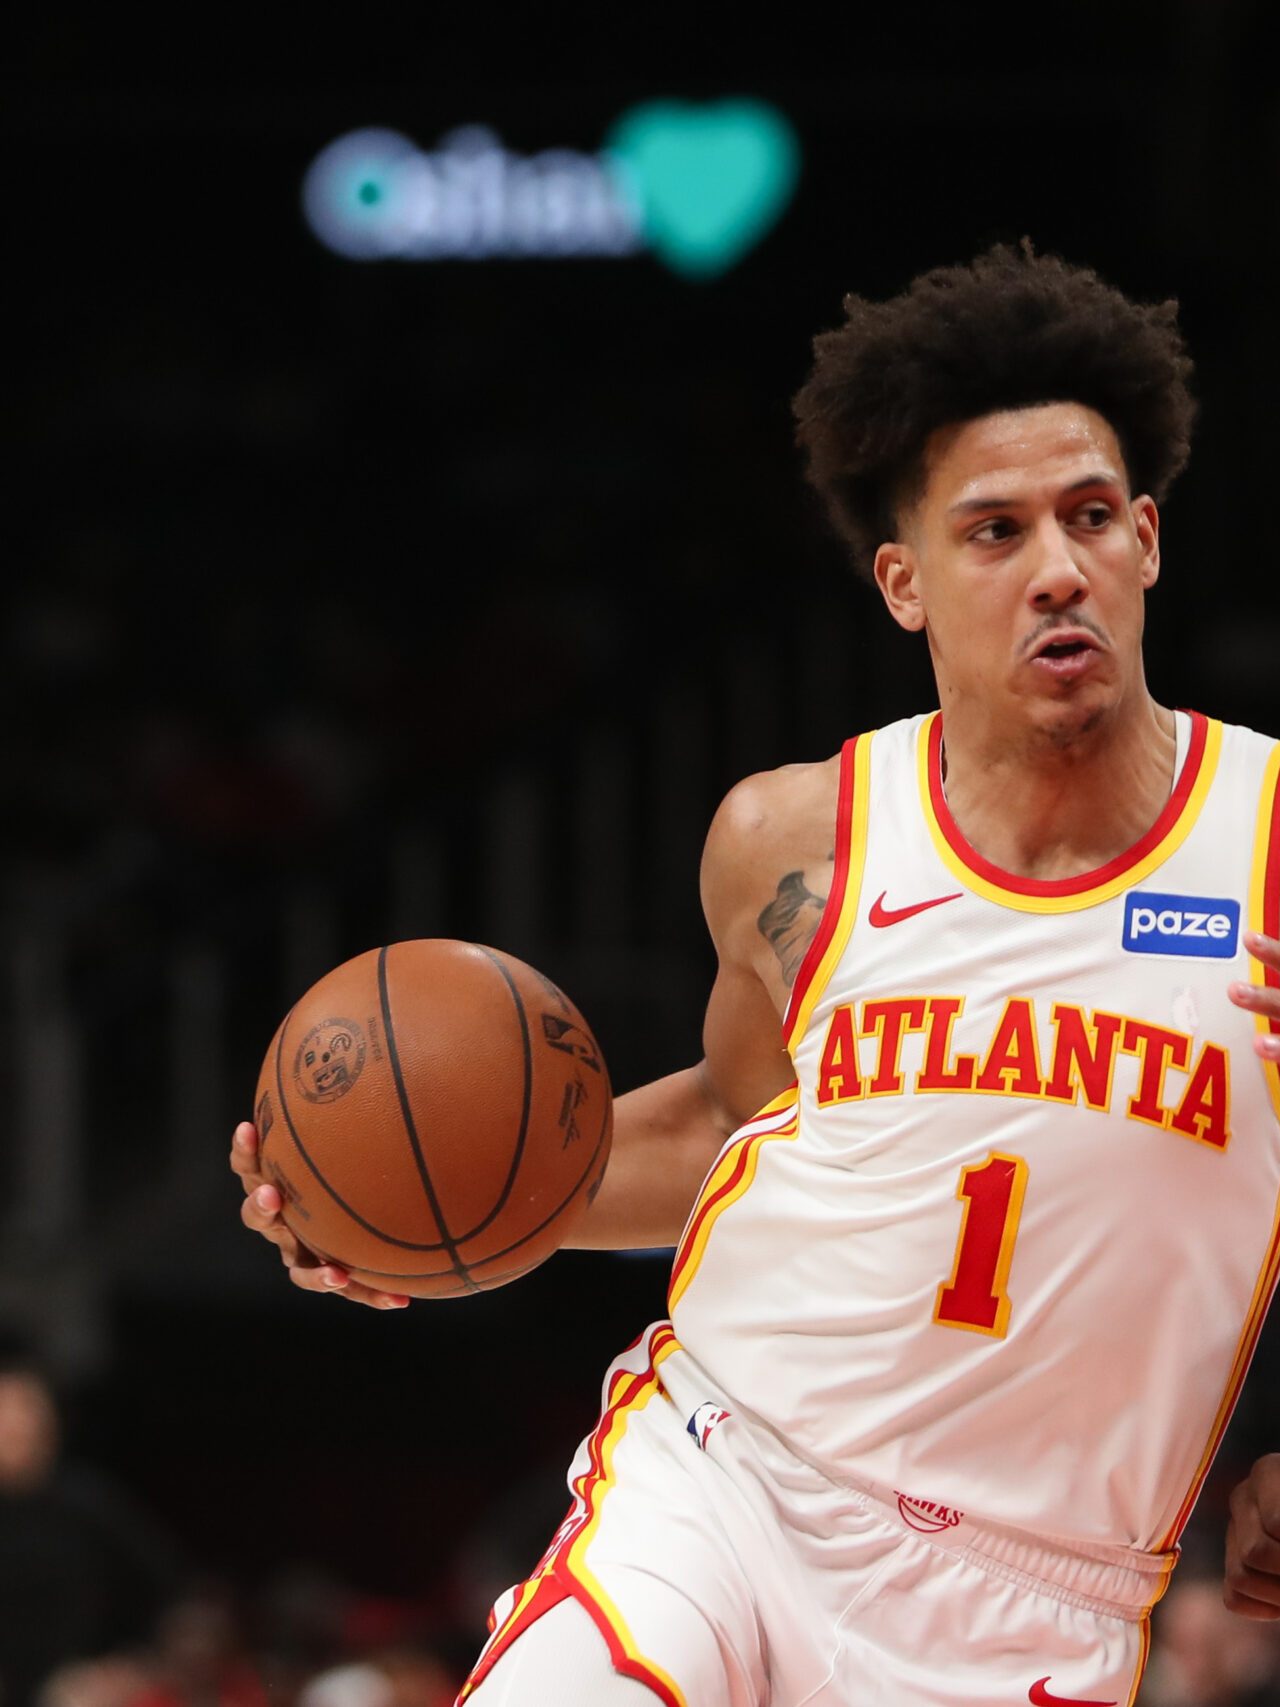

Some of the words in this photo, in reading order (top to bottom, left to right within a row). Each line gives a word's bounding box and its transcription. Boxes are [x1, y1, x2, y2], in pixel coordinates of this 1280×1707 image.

[1130, 907, 1232, 939] paze
[816, 995, 1231, 1153] ATLANTA
[932, 1151, 1028, 1339] 1
